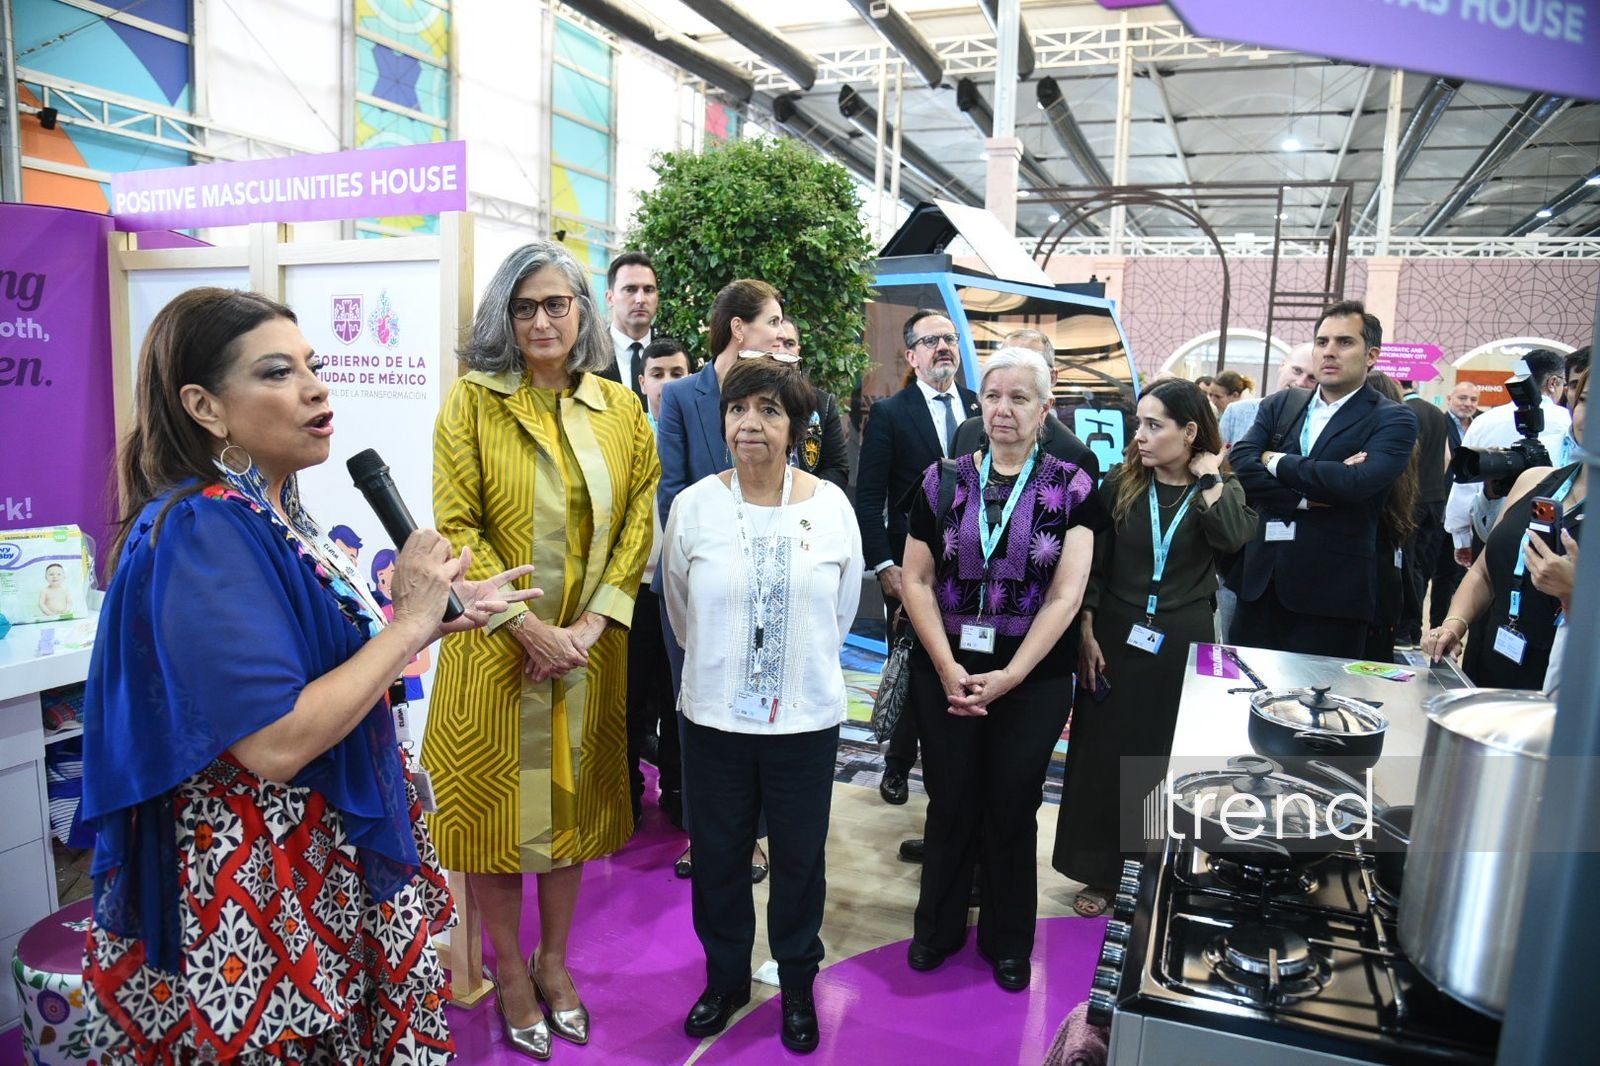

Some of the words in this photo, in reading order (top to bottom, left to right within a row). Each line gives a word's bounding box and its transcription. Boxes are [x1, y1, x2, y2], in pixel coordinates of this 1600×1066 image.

[115, 186, 197, 214] POSITIVE
[201, 171, 364, 208] MASCULINITIES
[370, 164, 457, 195] HOUSE
[1380, 346, 1410, 354] MOCRATIC
[385, 356, 403, 368] DE
[408, 356, 426, 368] LA
[359, 373, 375, 384] DE
[379, 370, 426, 386] MÉXICO
[1475, 384, 1503, 392] RNING
